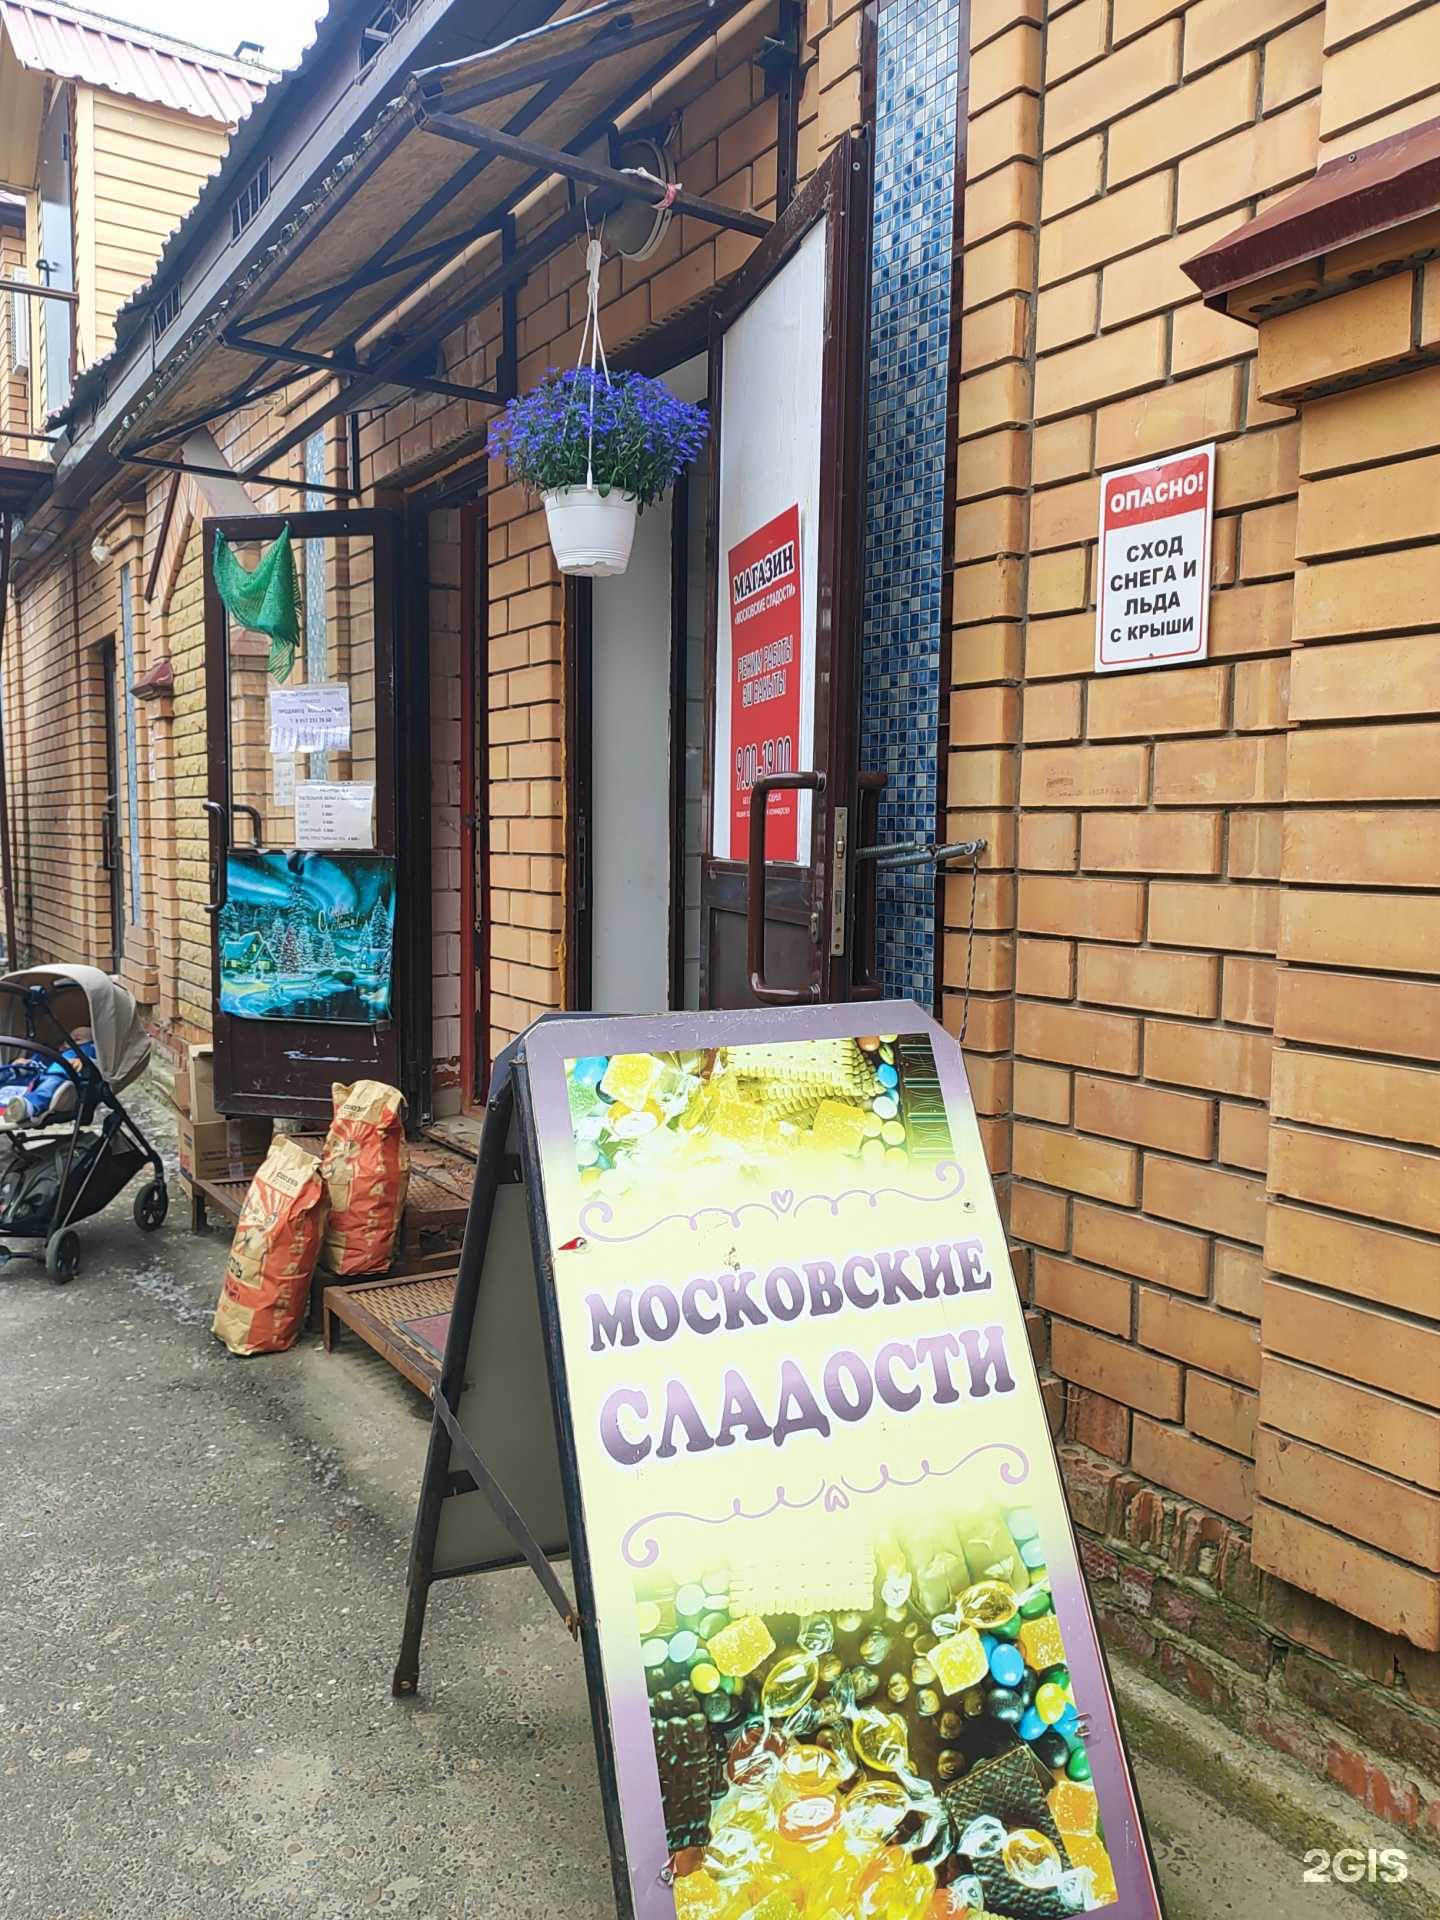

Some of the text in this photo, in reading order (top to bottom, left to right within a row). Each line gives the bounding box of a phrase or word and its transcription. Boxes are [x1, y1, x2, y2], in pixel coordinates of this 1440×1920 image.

[1110, 472, 1204, 513] ОПАСНО!
[1126, 535, 1183, 563] СХОД
[733, 541, 795, 604] МАГАЗИН
[1110, 560, 1197, 592] СНЕГА И
[1124, 591, 1181, 616] ЛЬДА
[1110, 617, 1194, 643] С КРЫШИ
[763, 635, 793, 673] РАБОТЫ
[736, 735, 792, 793] 9.00-1900
[585, 1239, 992, 1352] МОСКОВСКИЕ
[600, 1325, 1016, 1465] СЛАДОСТИ
